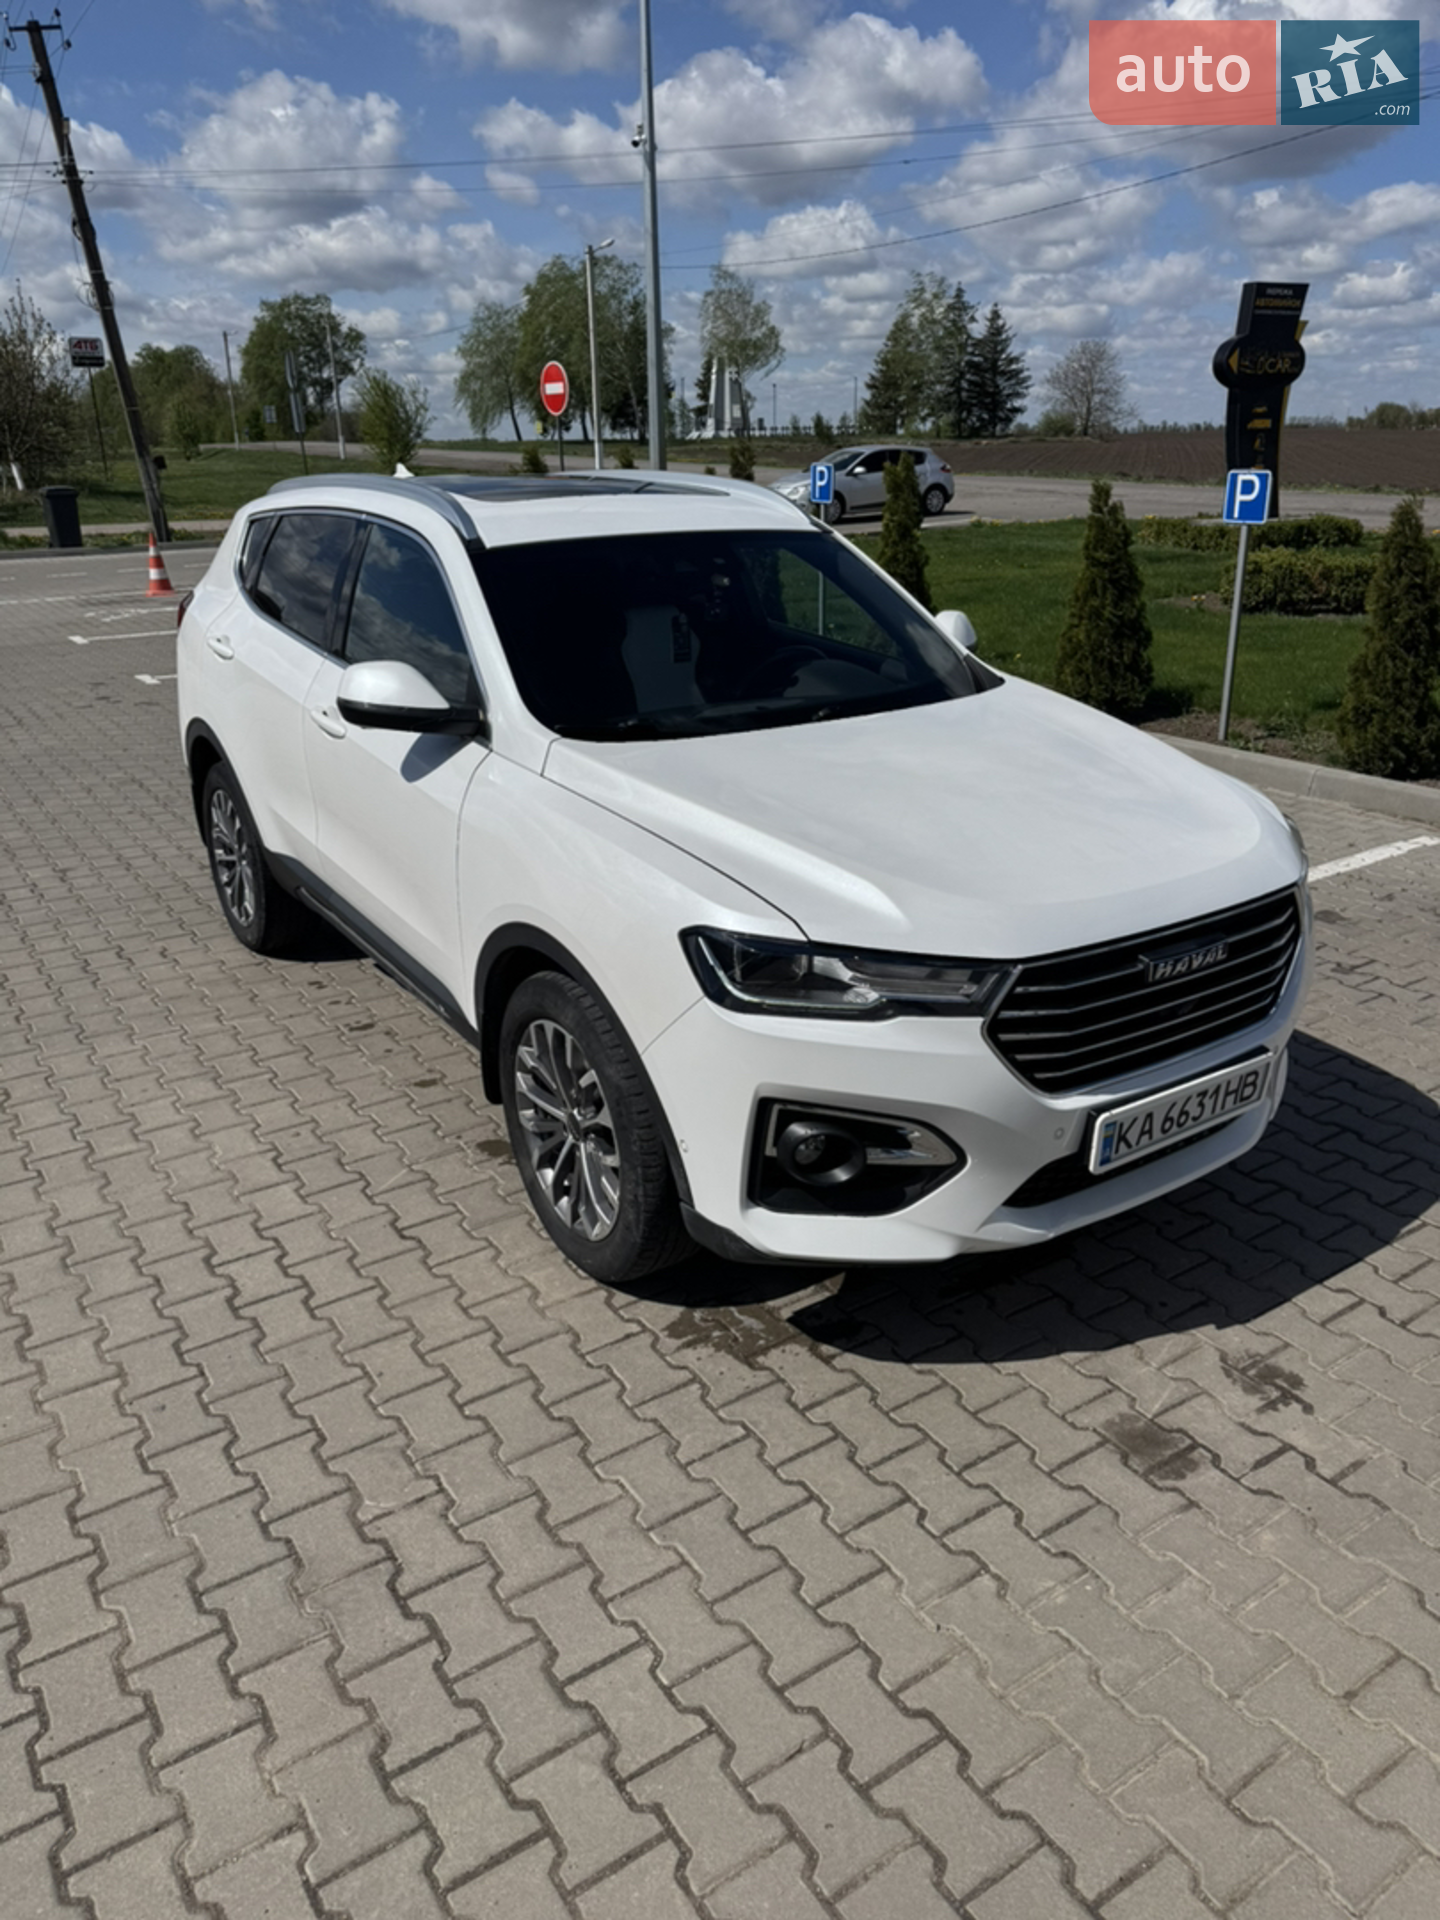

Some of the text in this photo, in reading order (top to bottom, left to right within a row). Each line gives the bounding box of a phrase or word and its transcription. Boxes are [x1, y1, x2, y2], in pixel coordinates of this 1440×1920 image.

[815, 465, 829, 499] P
[1233, 473, 1261, 519] P
[1154, 943, 1228, 980] HAVAL
